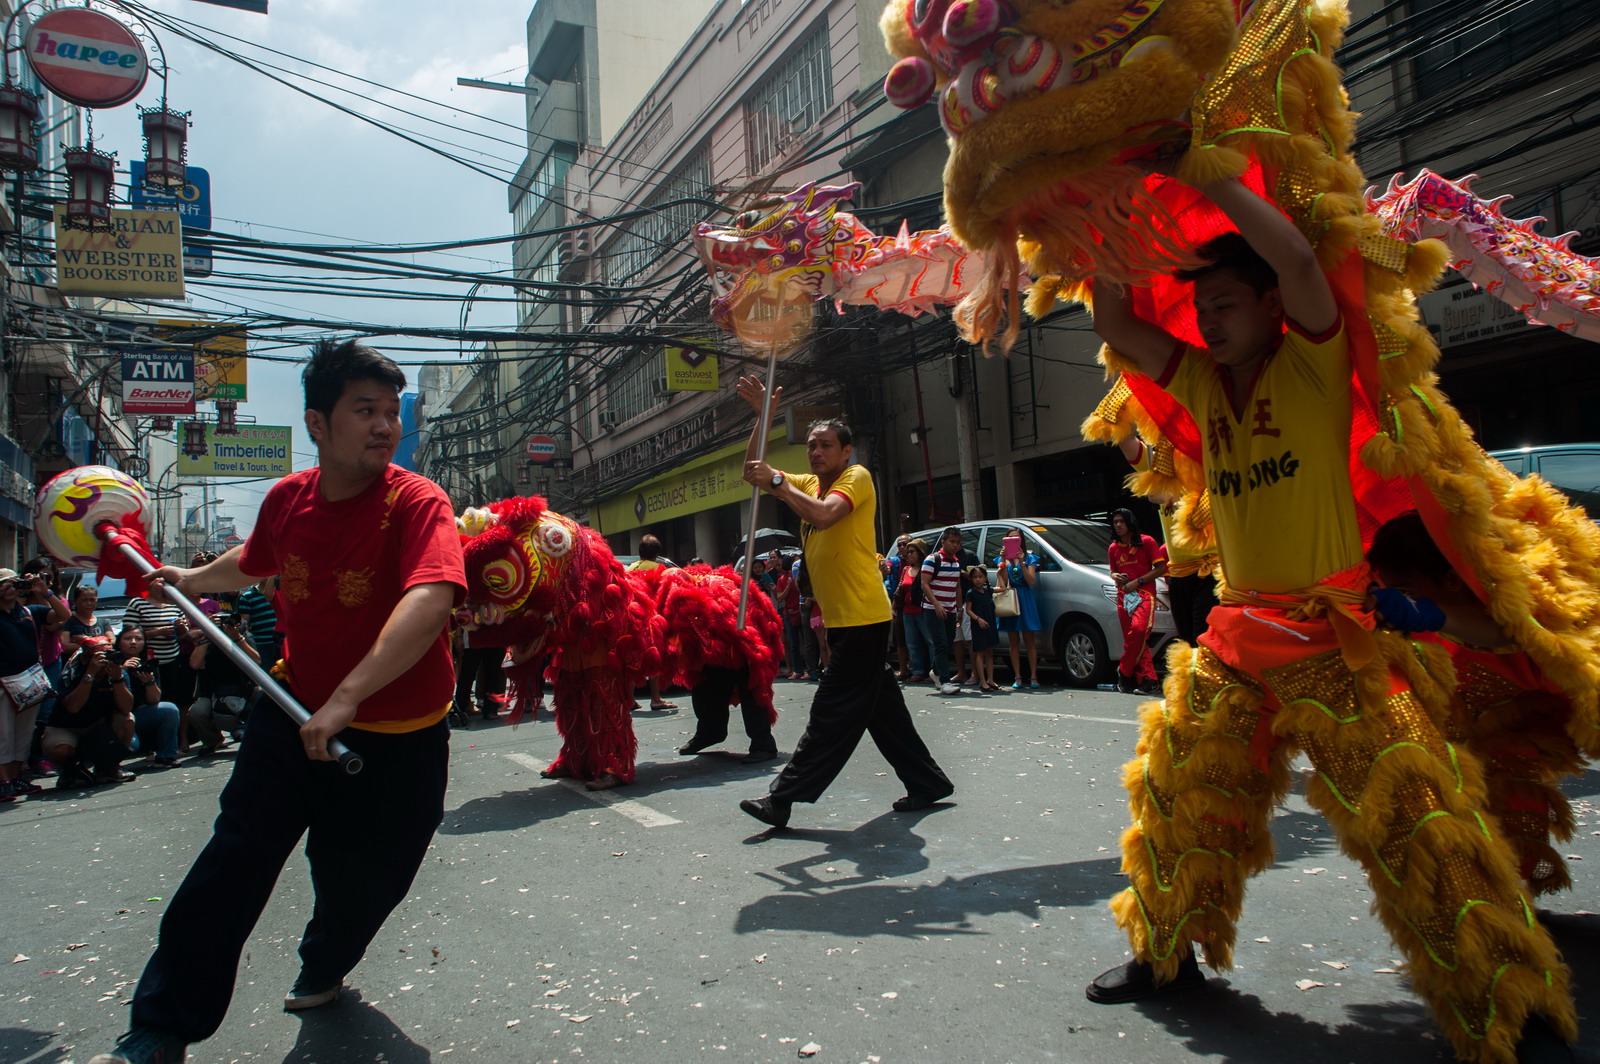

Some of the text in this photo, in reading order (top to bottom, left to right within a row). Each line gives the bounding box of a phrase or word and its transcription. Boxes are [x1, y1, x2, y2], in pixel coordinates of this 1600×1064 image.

[34, 32, 138, 69] hapee
[115, 234, 132, 249] &
[61, 249, 177, 268] WEBSTER
[63, 267, 178, 282] BOOKSTORE
[1451, 292, 1462, 302] NO
[1442, 303, 1485, 333] Super
[123, 352, 151, 361] Sterling
[131, 361, 185, 379] ATM
[674, 369, 713, 379] eastwest
[129, 388, 192, 398] BancNet
[213, 442, 286, 459] Timberfield
[213, 462, 286, 472] Travel & Tours, Inc.
[647, 480, 688, 513] eastwest
